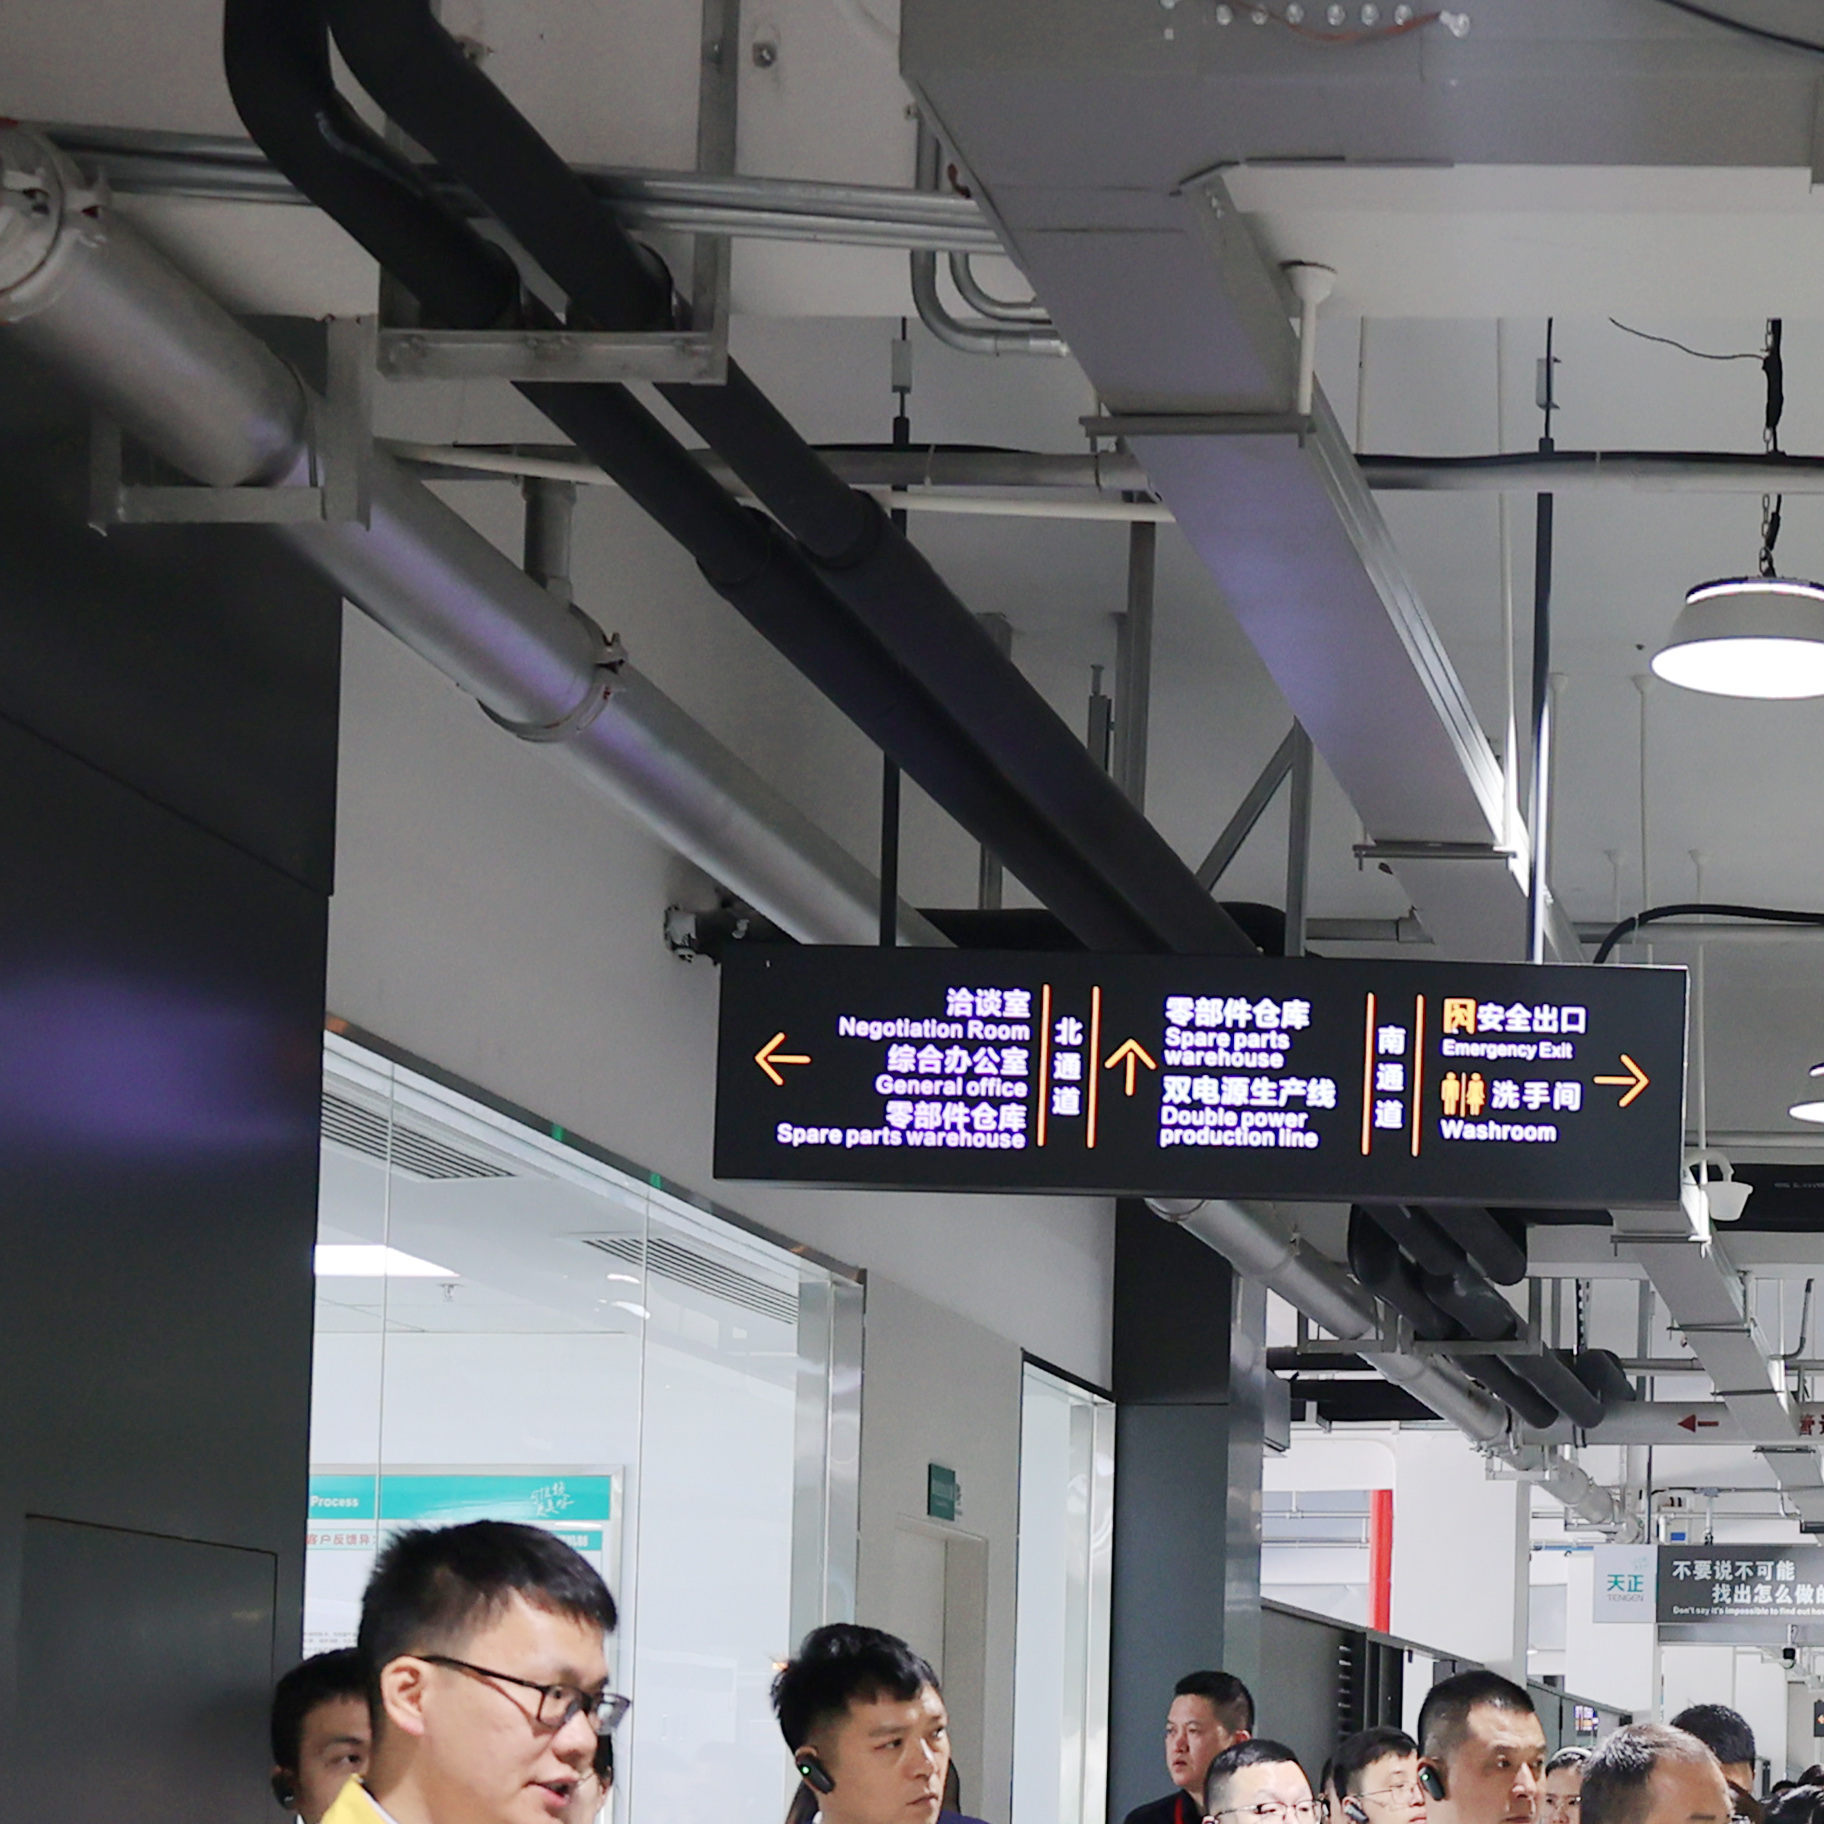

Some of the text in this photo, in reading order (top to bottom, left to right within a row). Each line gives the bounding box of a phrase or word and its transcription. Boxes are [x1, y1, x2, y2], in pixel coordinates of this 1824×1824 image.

[946, 987, 1031, 1018] 洽谈室
[1165, 996, 1310, 1030] 零部件仓库
[838, 1016, 1031, 1041] Negotiation Room
[1477, 1002, 1586, 1034] 安全出口
[1165, 1026, 1290, 1051] Spare parts
[1442, 1038, 1573, 1061] Emergency Exit
[887, 1043, 1029, 1076] 综合办公室
[1051, 1016, 1083, 1116] 北通道
[1164, 1048, 1284, 1068] warehouse
[875, 1074, 1028, 1098] General office
[1374, 1025, 1406, 1129] 南通道
[1162, 1075, 1336, 1109] 双电源生产线
[1491, 1079, 1581, 1111] 洗手间
[886, 1100, 1028, 1132] 零部件仓库
[1161, 1105, 1308, 1129] Double power
[777, 1122, 1026, 1149] Spare parts warehouse
[1160, 1126, 1319, 1149] production line
[1440, 1119, 1557, 1142] Washroom
[310, 1494, 359, 1508] Process
[1607, 1574, 1644, 1592] 天正
[1672, 1560, 1795, 1581] 不要说不可能
[1672, 1606, 1695, 1615] Don't
[1696, 1607, 1710, 1616] say
[1725, 1606, 1768, 1617] impossible
[1770, 1607, 1779, 1615] to
[1779, 1606, 1796, 1615] find
[1797, 1608, 1810, 1616] out
